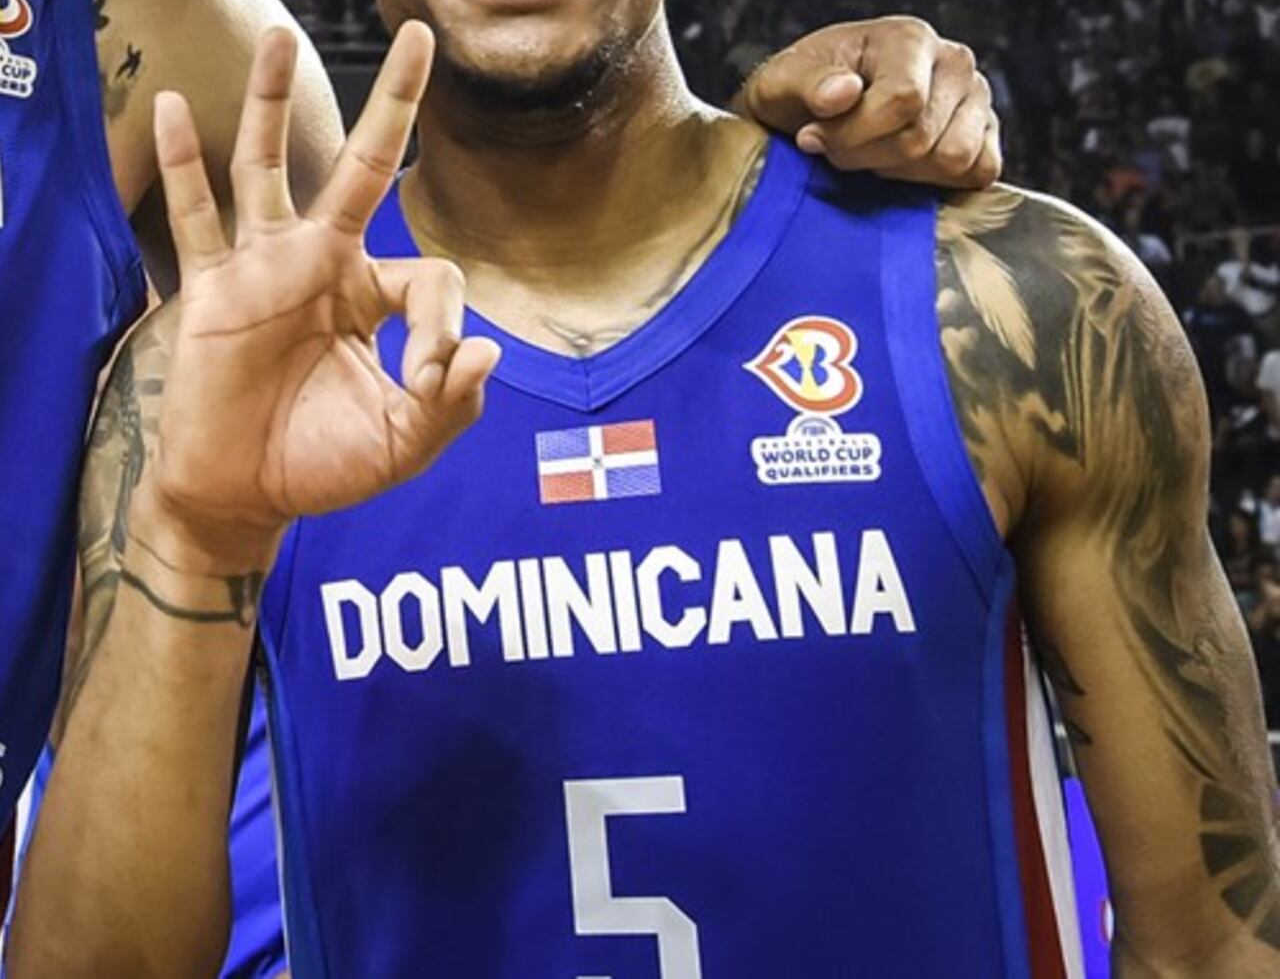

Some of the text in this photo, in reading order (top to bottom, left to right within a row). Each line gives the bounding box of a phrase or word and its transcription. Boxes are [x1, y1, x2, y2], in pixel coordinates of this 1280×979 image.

[1, 63, 32, 80] CUP
[761, 446, 874, 464] WORLD CUP
[765, 464, 874, 480] QUALIFIERS
[320, 528, 916, 681] DOMINICANA
[563, 775, 703, 979] 5
